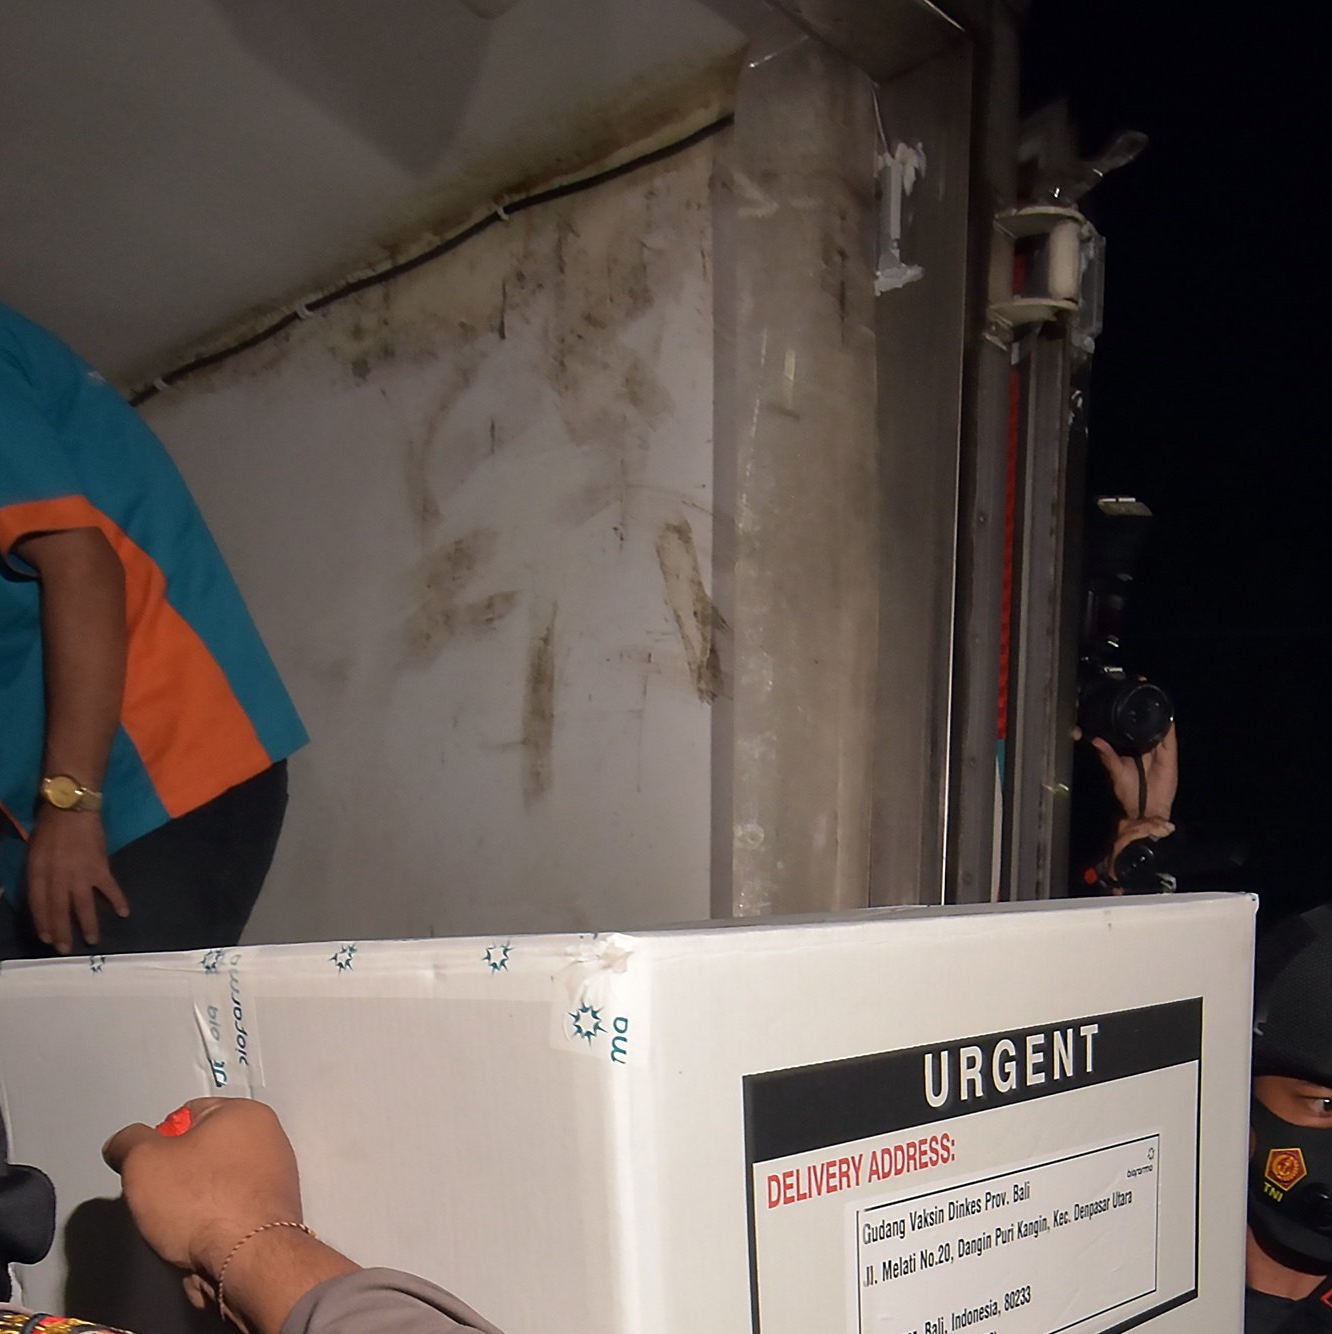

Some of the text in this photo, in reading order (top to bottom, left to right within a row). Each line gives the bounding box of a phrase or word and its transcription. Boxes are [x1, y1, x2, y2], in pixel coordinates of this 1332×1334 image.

[923, 1023, 1099, 1109] URGENT
[767, 1132, 956, 1209] DELIVERY ADDRESS:
[1263, 1181, 1284, 1203] TNI
[862, 1181, 1031, 1245] Gudang Vaksin Dinkes Prov. Bali
[882, 1253, 916, 1282] Melati
[920, 1243, 954, 1270] No.20,
[958, 1232, 992, 1258] Dangin
[995, 1223, 1014, 1246] Puri
[1017, 1215, 1050, 1239] Kangin,
[1053, 1209, 1071, 1228] Kec.
[1073, 1197, 1110, 1221] Denpasar
[1112, 1190, 1133, 1208] Utara
[951, 1299, 1001, 1332] Indonesia,
[1004, 1285, 1031, 1311] 80233
